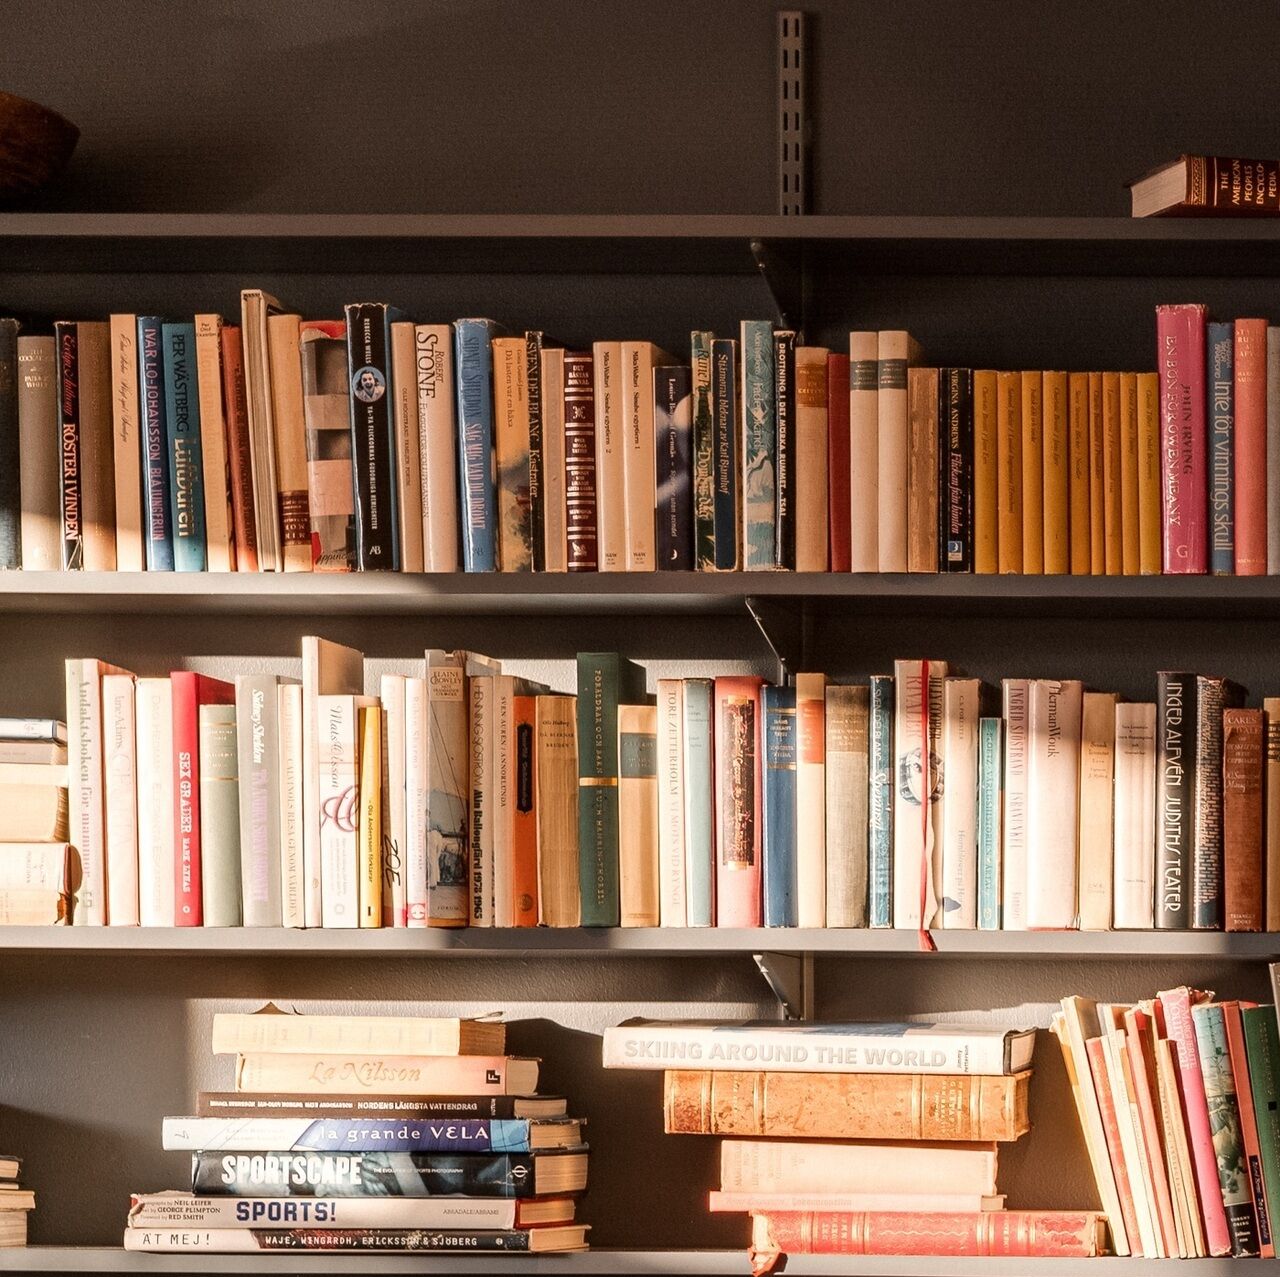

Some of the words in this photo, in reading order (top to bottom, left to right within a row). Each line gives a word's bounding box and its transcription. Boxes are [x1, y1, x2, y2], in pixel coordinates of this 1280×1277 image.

[145, 328, 157, 357] IVAR
[172, 334, 186, 356] PER
[417, 332, 437, 398] STONE
[435, 351, 444, 382] ROBERT
[146, 363, 161, 460] LO-JOHANSSON
[174, 361, 190, 432] WÄSTBERG
[1214, 381, 1231, 411] Inte
[1215, 415, 1231, 436] för
[63, 424, 77, 476] RÖSTER
[174, 438, 197, 537] Luftburen
[1211, 440, 1232, 510] vinnings
[65, 486, 79, 540] VINDEN
[1214, 513, 1232, 551] skull
[1166, 682, 1181, 726] INGER
[79, 680, 92, 782] Andaktsboken
[179, 752, 191, 779] SEX
[1167, 728, 1184, 786] ALFVÉN
[81, 786, 92, 810] för
[1164, 794, 1181, 853] JUDITHS
[1164, 859, 1181, 911] TEATER
[625, 1040, 702, 1059] SKIING
[710, 1041, 808, 1064] AROUND
[814, 1046, 857, 1064] THE
[864, 1047, 946, 1067] WORLD
[349, 1127, 422, 1142] grande
[222, 1156, 362, 1187] SPORTSCAPE
[236, 1201, 336, 1222] SPORTS!
